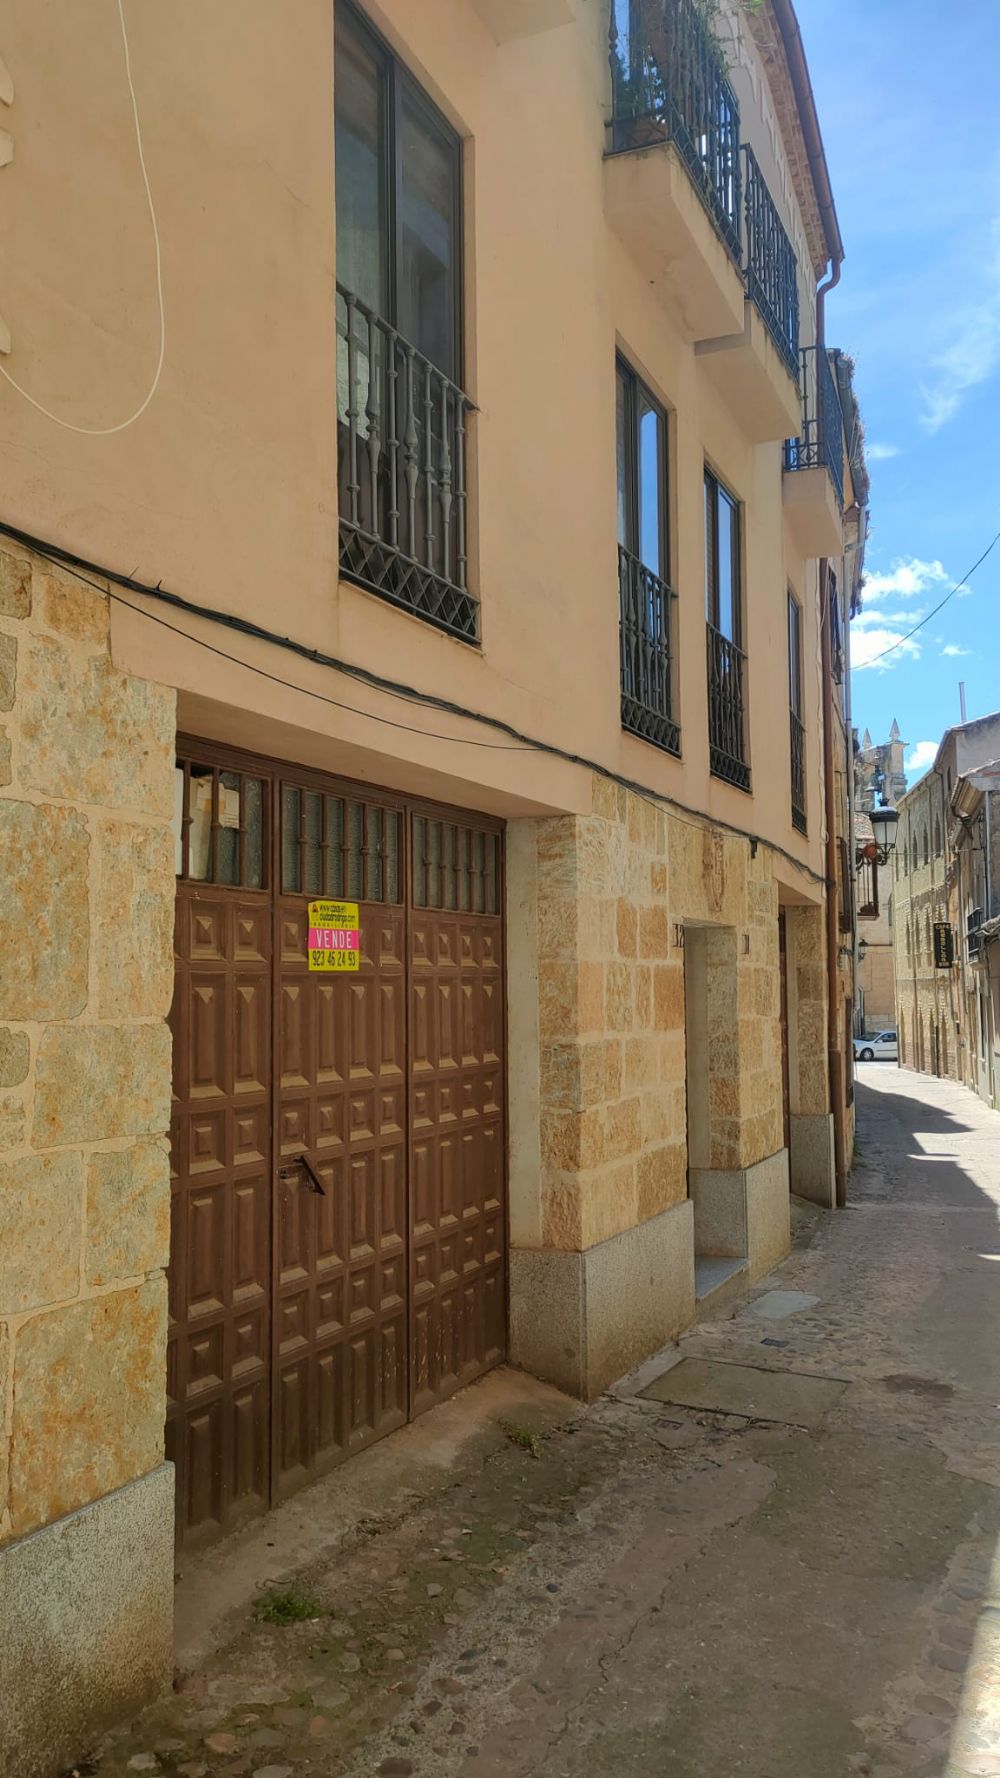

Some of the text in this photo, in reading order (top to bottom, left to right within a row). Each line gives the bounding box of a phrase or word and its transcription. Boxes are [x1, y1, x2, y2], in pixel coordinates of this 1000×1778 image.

[316, 930, 352, 949] VENDE
[312, 951, 325, 966] 923
[337, 952, 346, 967] 24
